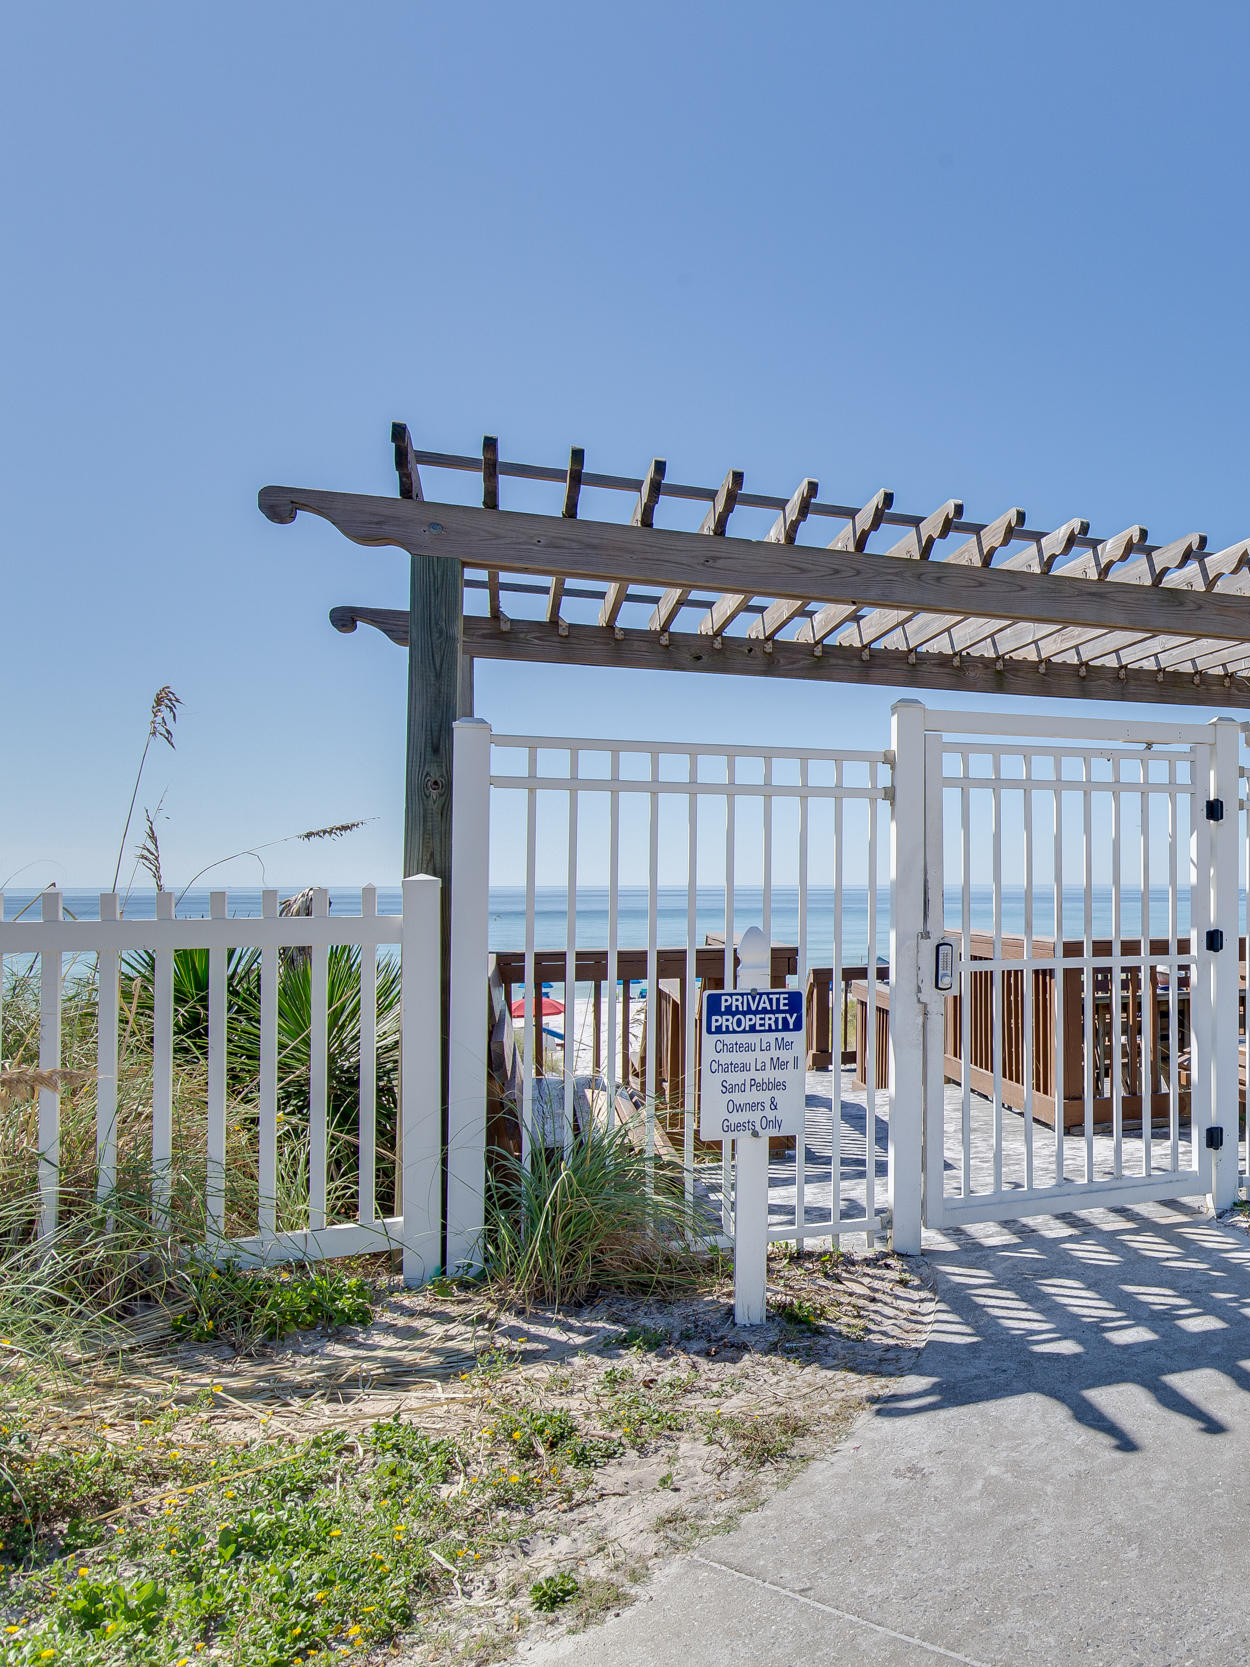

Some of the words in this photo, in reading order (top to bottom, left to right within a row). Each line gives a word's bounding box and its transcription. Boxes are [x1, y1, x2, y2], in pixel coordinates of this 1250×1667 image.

[721, 994, 789, 1012] PRIVATE
[711, 1013, 797, 1032] PROPERTY
[715, 1039, 756, 1053] Chateau
[760, 1038, 771, 1051] La
[774, 1037, 794, 1051] Mer
[710, 1059, 750, 1074] Chateau
[755, 1058, 766, 1071] La
[770, 1057, 789, 1071] Mer
[793, 1056, 798, 1070] II
[721, 1079, 746, 1094] Sand
[750, 1077, 787, 1092] Pebbles
[727, 1099, 765, 1114] Owners
[770, 1096, 778, 1111] &
[722, 1118, 756, 1133] Guests
[760, 1115, 782, 1132] Only
